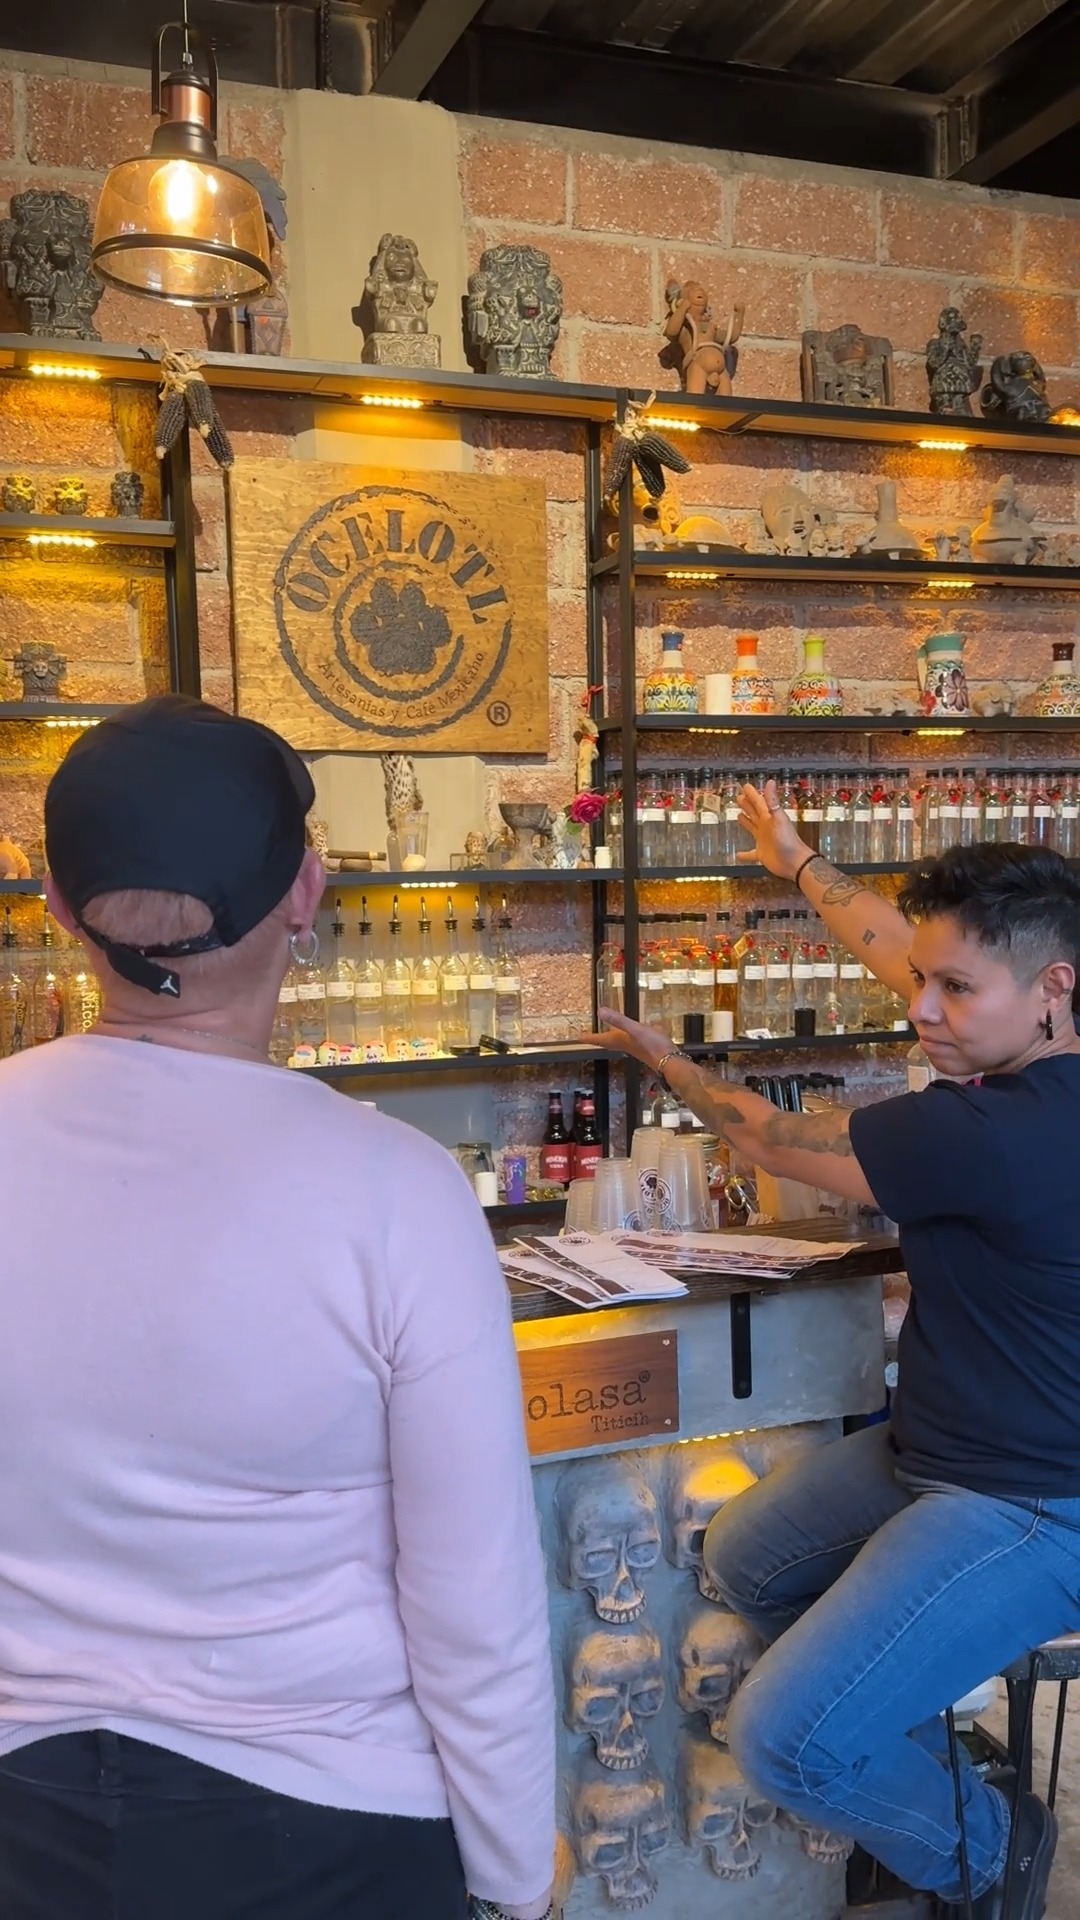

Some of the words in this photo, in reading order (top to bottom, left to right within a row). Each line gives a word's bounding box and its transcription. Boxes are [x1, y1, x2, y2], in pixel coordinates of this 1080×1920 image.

[286, 509, 508, 624] OCELOTL
[390, 710, 399, 723] y
[437, 652, 485, 709] Mexicano
[81, 990, 96, 1033] Nico
